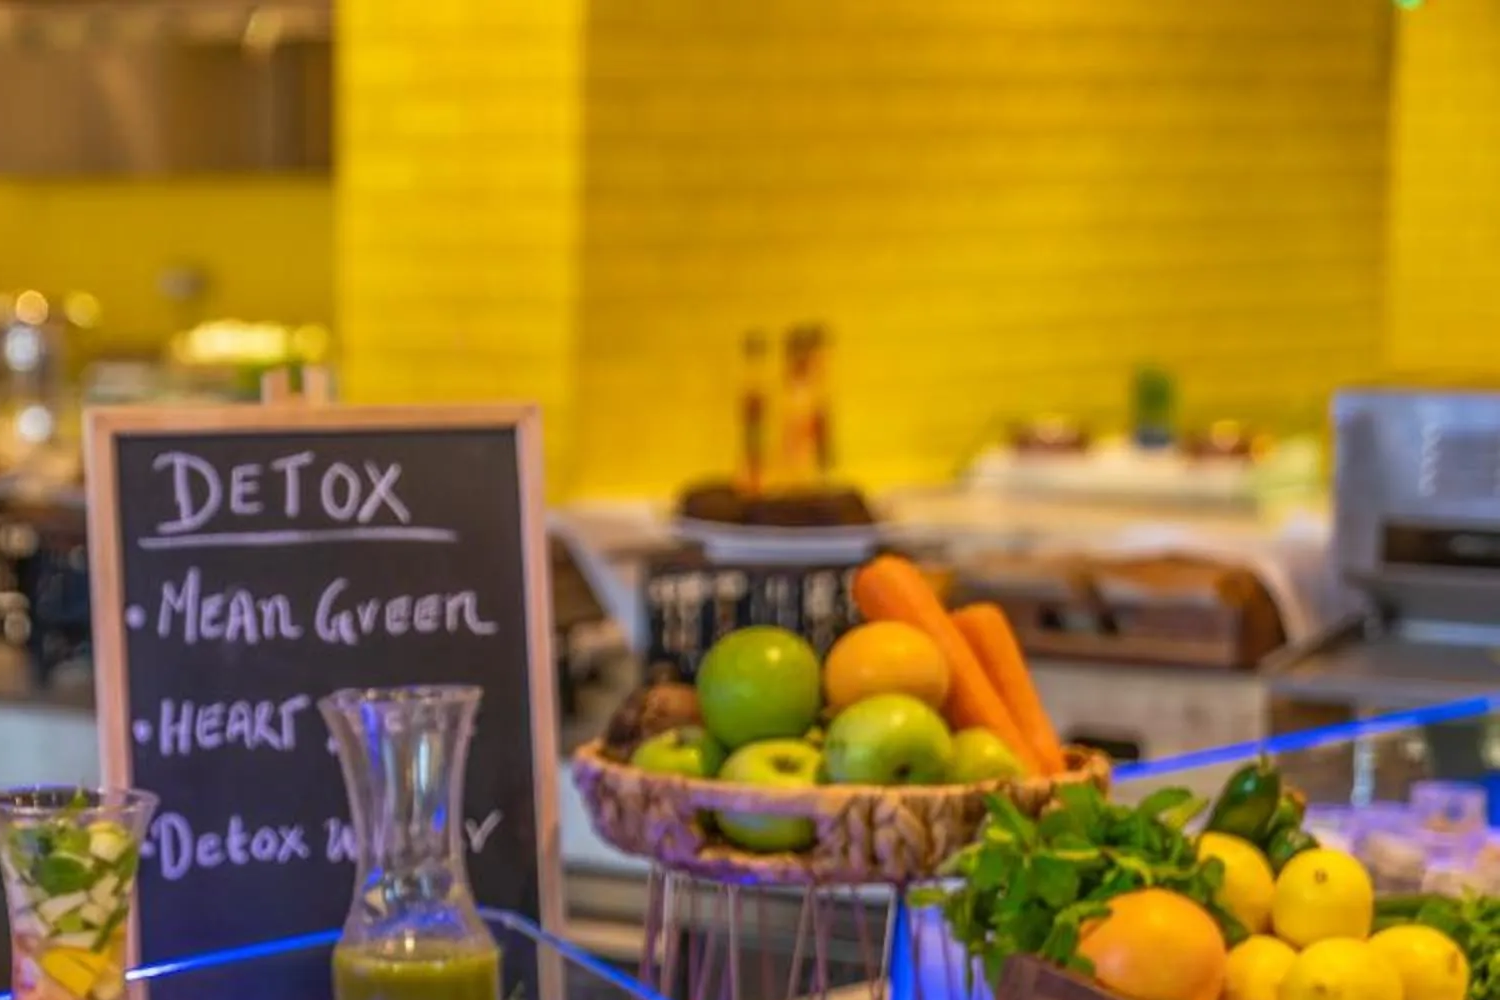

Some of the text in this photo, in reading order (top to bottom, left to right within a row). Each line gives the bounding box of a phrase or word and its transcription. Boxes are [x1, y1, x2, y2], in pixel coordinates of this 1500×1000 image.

[153, 451, 411, 534] DETOX
[159, 694, 310, 756] HEART
[152, 811, 310, 879] Detox
